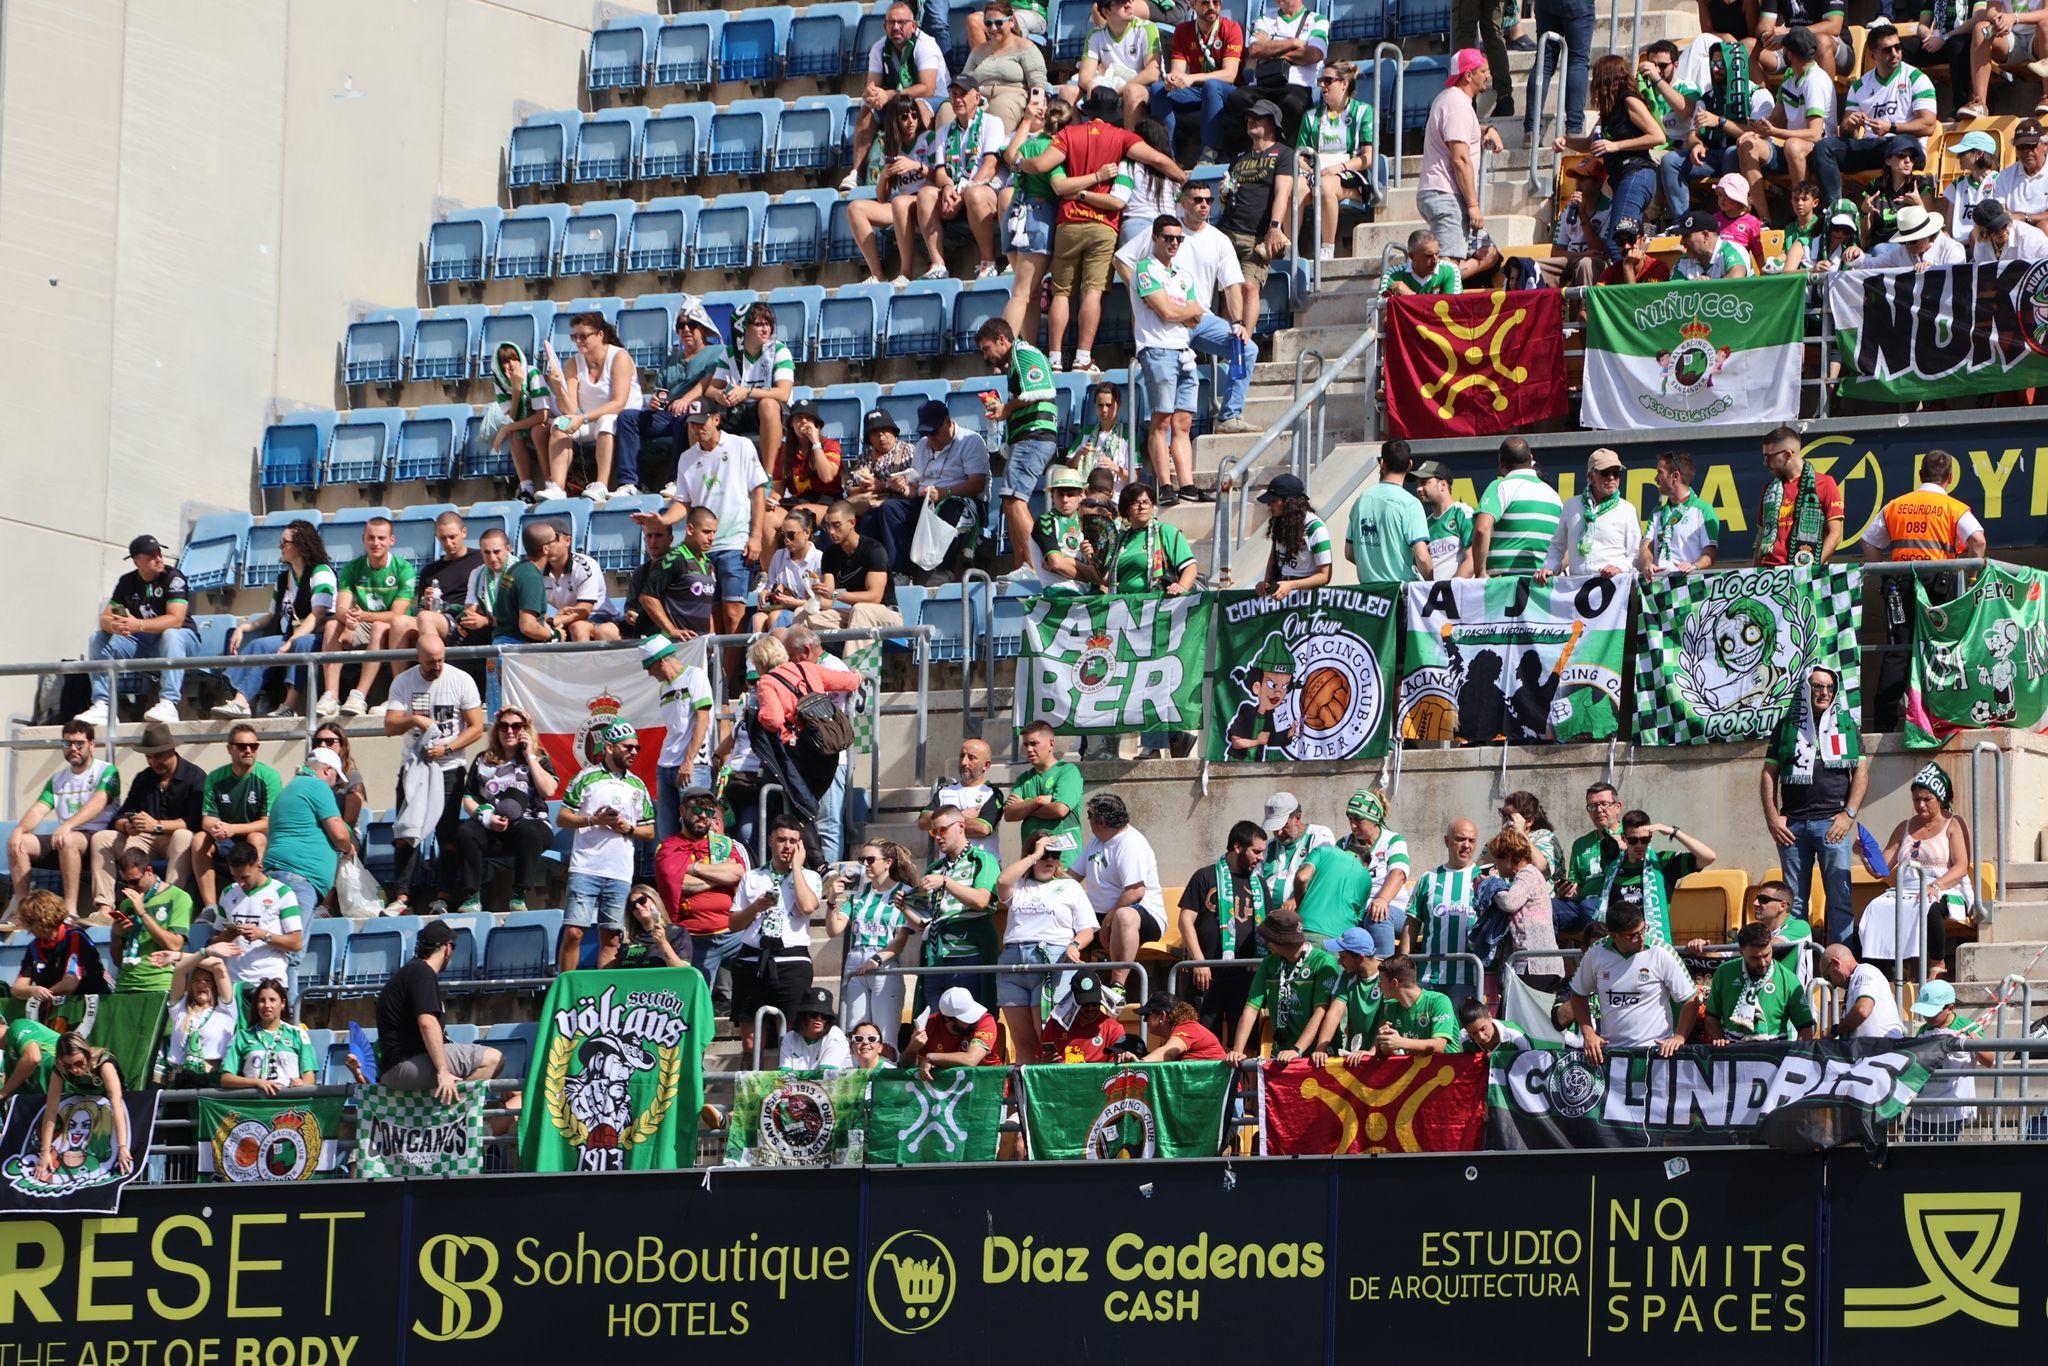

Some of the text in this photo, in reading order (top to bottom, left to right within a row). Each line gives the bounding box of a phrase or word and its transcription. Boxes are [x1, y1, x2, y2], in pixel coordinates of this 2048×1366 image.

[1634, 290, 1754, 332] NIÑUC@S
[1897, 502, 1944, 518] SEGURIDAD
[1906, 520, 1928, 535] 089
[1711, 569, 1792, 600] LOCOS
[1282, 608, 1343, 641] On tour
[1703, 706, 1783, 739] POR TI
[1606, 989, 1640, 1007] teka
[795, 1084, 816, 1096] 1913
[806, 1102, 834, 1157] ASTILLERO
[1104, 1100, 1141, 1118] RACING
[1143, 1112, 1155, 1143] CLUB
[575, 1143, 624, 1171] 1913
[1609, 1197, 1689, 1241] NO
[983, 1231, 1325, 1284] Díaz Cadenas
[1421, 1229, 1582, 1268] ESTUDIO
[0, 1211, 366, 1324] RESET
[513, 1232, 850, 1300] SohoBoutique
[1608, 1244, 1806, 1288] LIMITS
[1104, 1290, 1199, 1322] CASH
[1350, 1273, 1580, 1305] DE ARQUITECTURA
[608, 1301, 750, 1337] HOTELS
[1608, 1293, 1806, 1332] SPACES
[78, 1340, 157, 1366] ART
[235, 1336, 358, 1366] BODY
